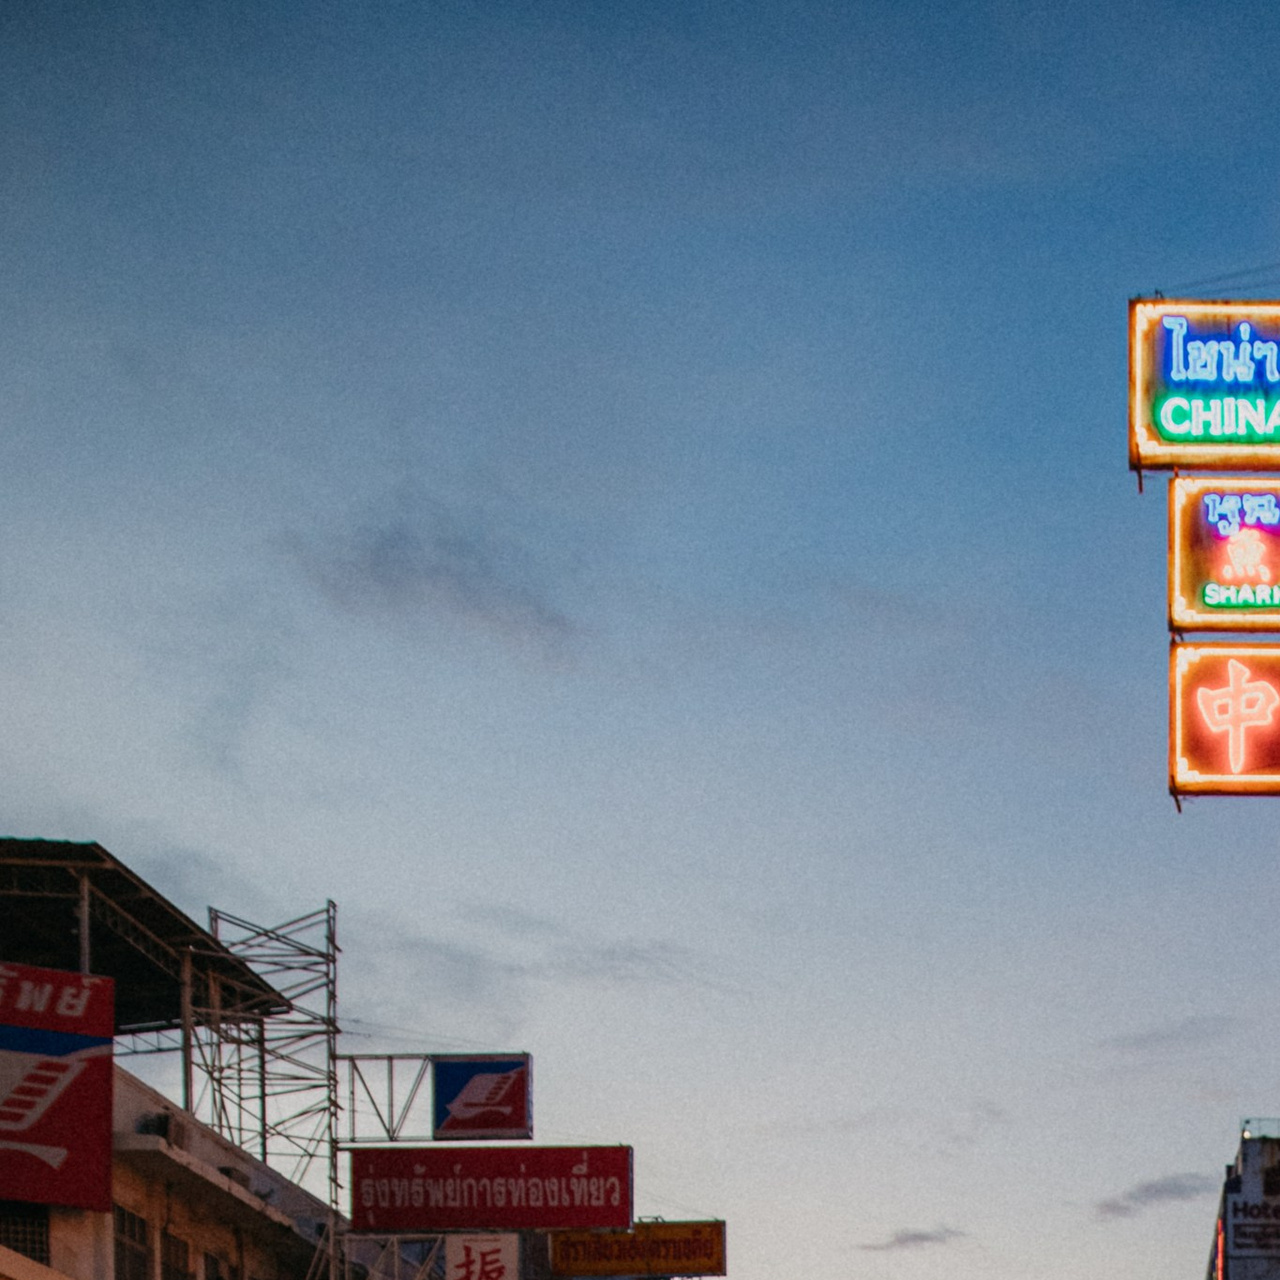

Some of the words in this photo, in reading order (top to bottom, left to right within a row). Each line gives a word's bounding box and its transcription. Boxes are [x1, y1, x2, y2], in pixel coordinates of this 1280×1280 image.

[360, 1150, 621, 1226] รุ่งทรัพย์การท่องเที่ยว
